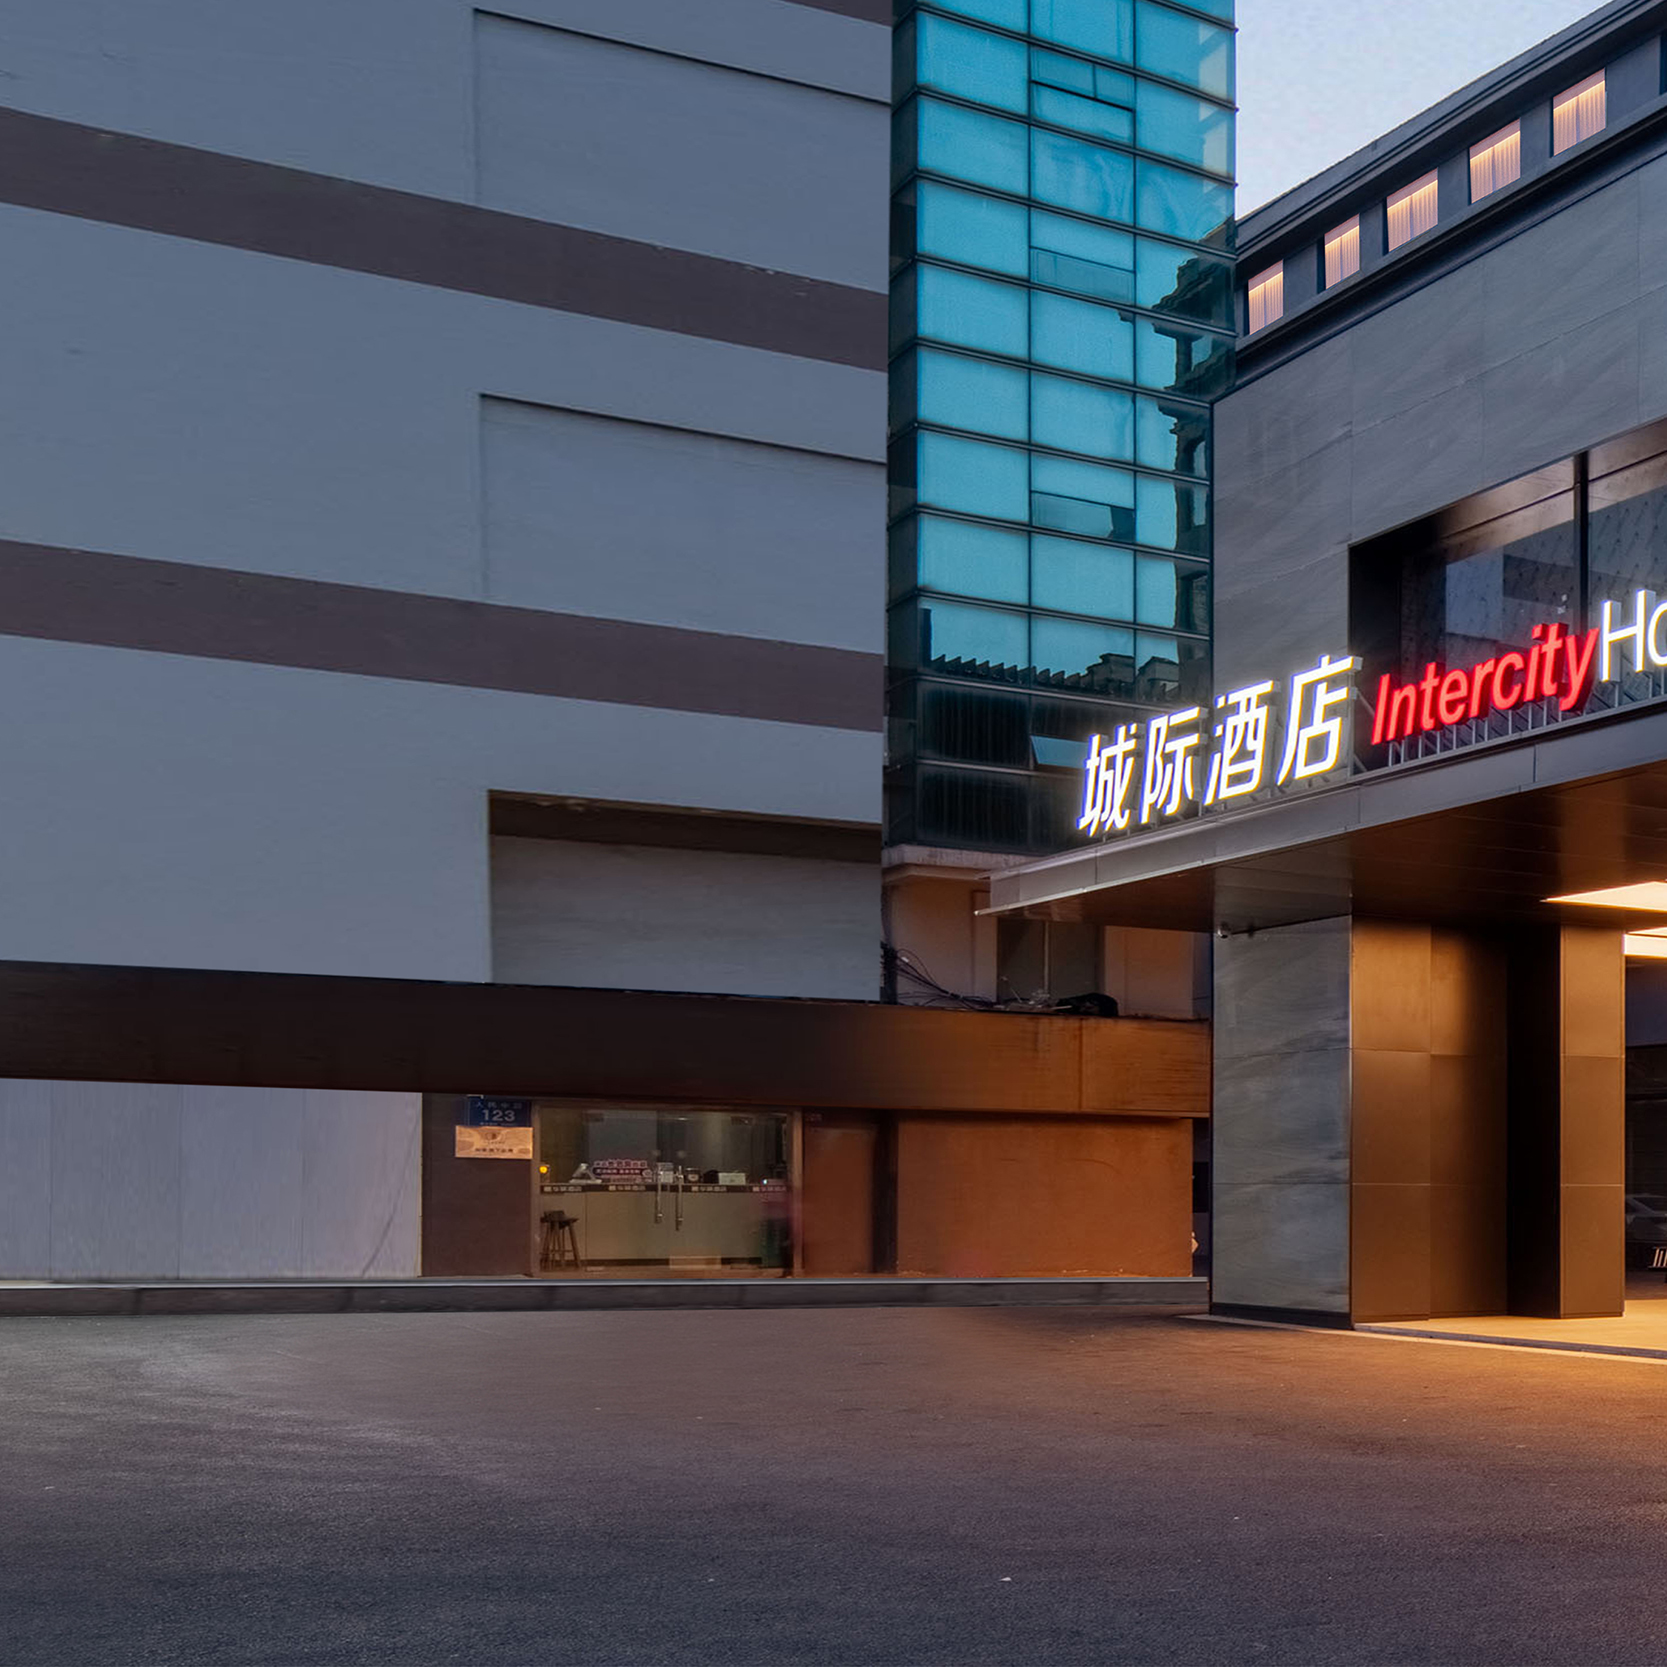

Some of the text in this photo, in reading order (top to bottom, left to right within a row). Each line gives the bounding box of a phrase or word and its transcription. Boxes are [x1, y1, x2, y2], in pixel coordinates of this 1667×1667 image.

[1076, 654, 1358, 837] 城际酒店
[482, 1110, 516, 1121] 123
